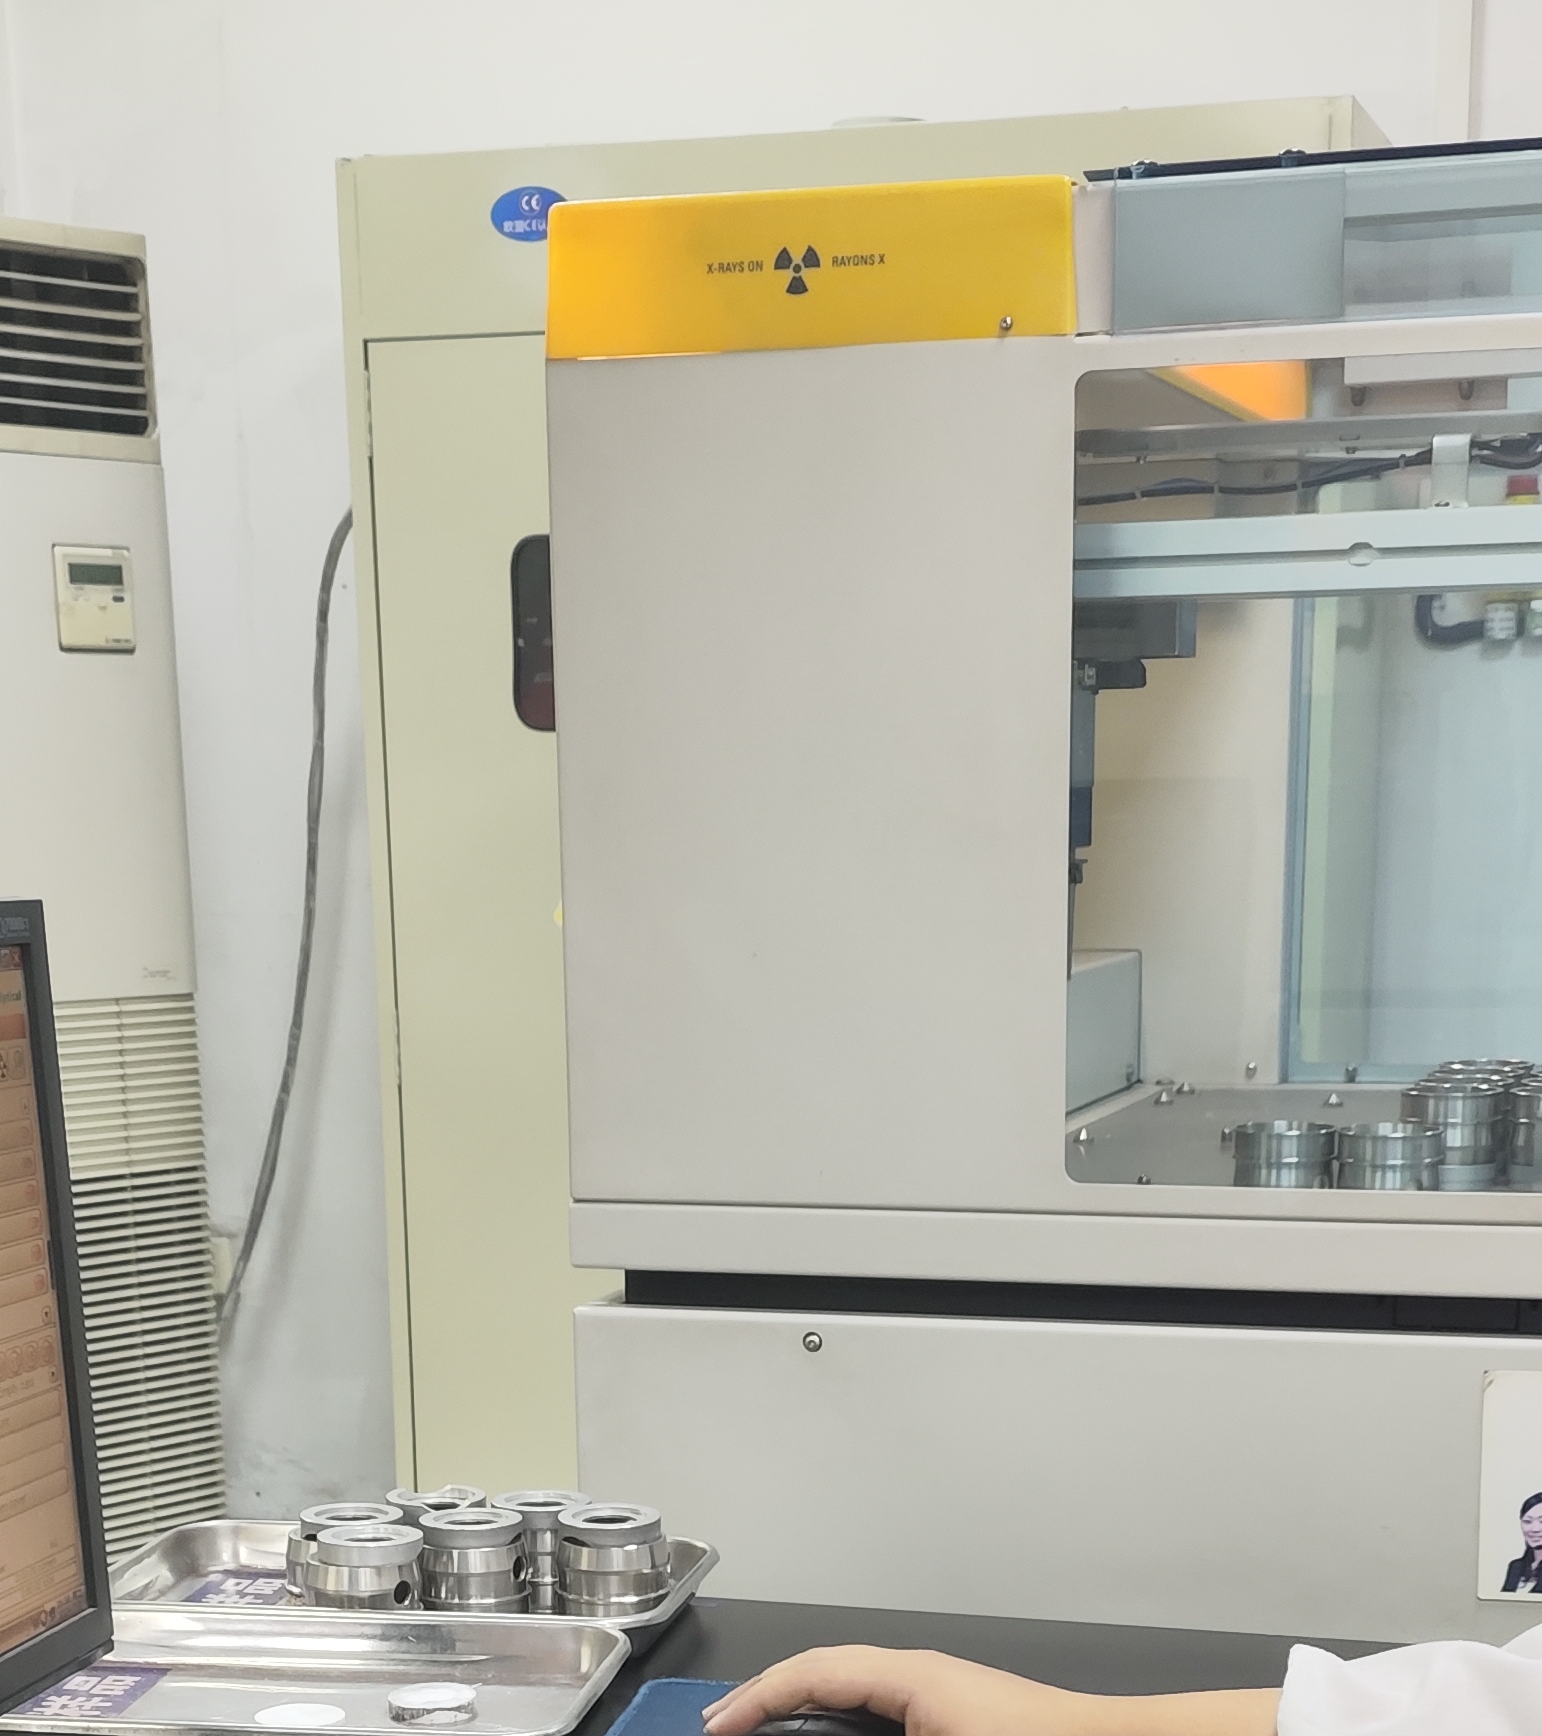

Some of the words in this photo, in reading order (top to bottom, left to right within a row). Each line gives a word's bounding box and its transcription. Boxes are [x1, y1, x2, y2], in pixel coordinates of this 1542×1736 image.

[706, 261, 744, 275] X-RAYS
[747, 260, 764, 272] ON
[831, 254, 875, 268] RAYONS
[877, 253, 886, 265] X
